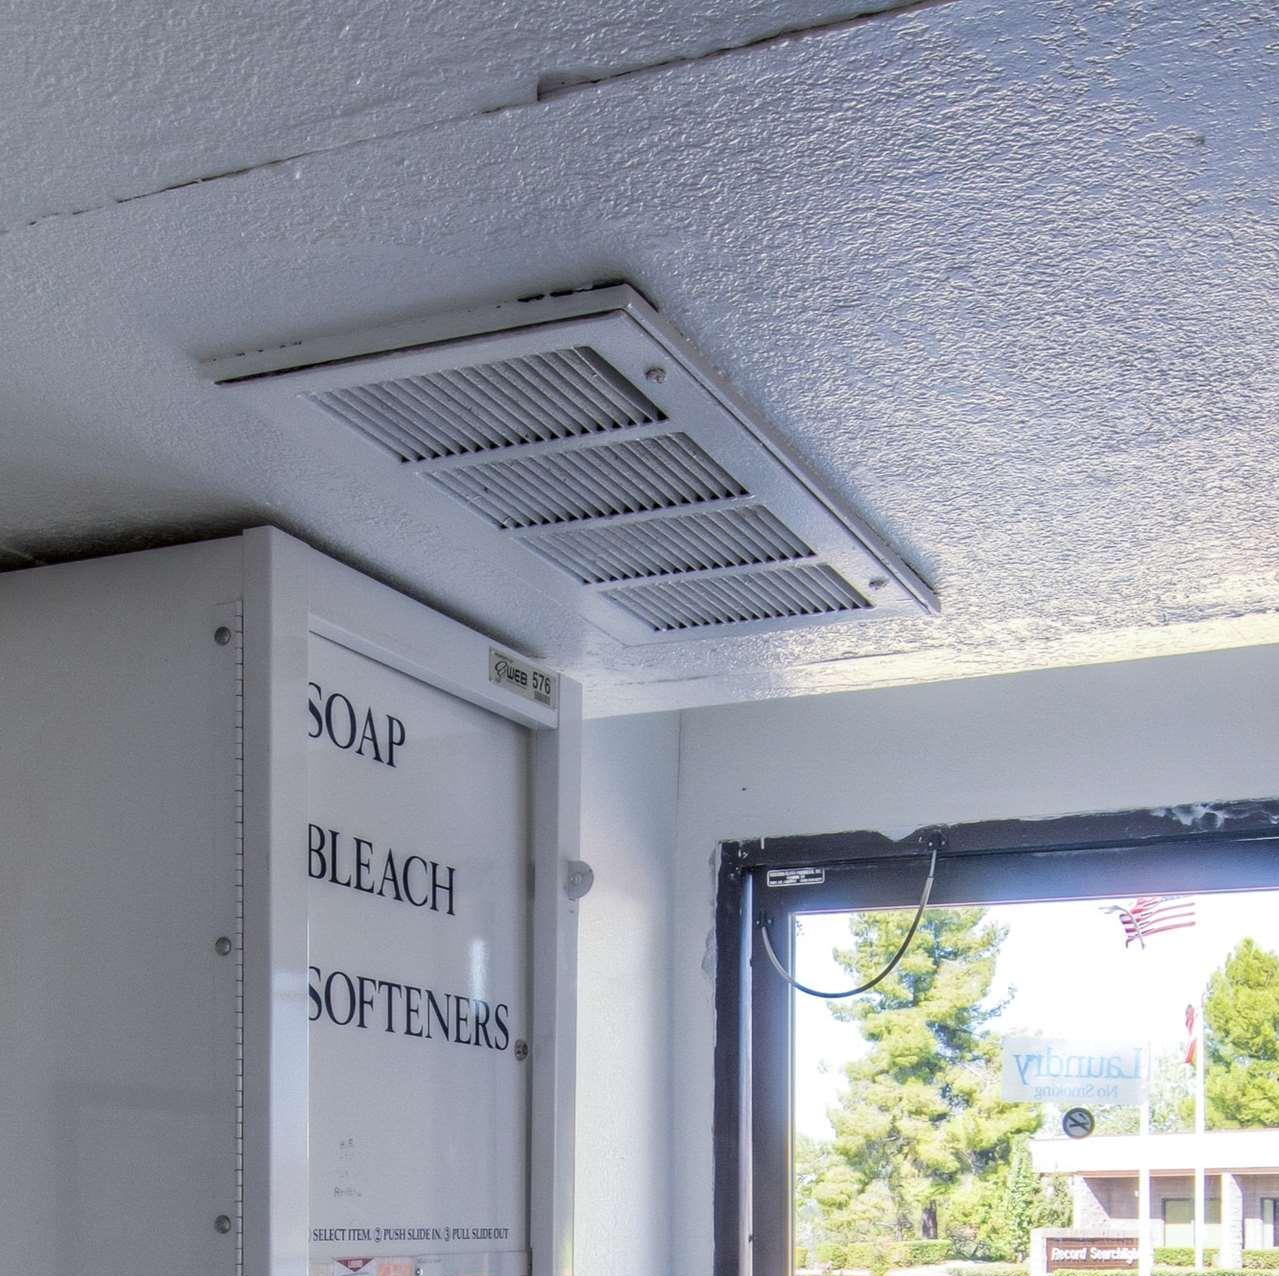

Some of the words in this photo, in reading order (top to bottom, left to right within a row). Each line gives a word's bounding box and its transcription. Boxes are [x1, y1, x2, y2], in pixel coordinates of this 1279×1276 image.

[308, 681, 406, 768] SOAP
[532, 671, 551, 695] 576
[308, 823, 456, 916] BLEACH
[308, 965, 510, 1051] SOFTENERS
[312, 1227, 347, 1242] SELECT
[383, 1227, 406, 1241] PUSH
[407, 1227, 431, 1241] SLIDE
[452, 1227, 470, 1240] PULL
[471, 1227, 492, 1240] SLIDE
[493, 1227, 509, 1240] OUT
